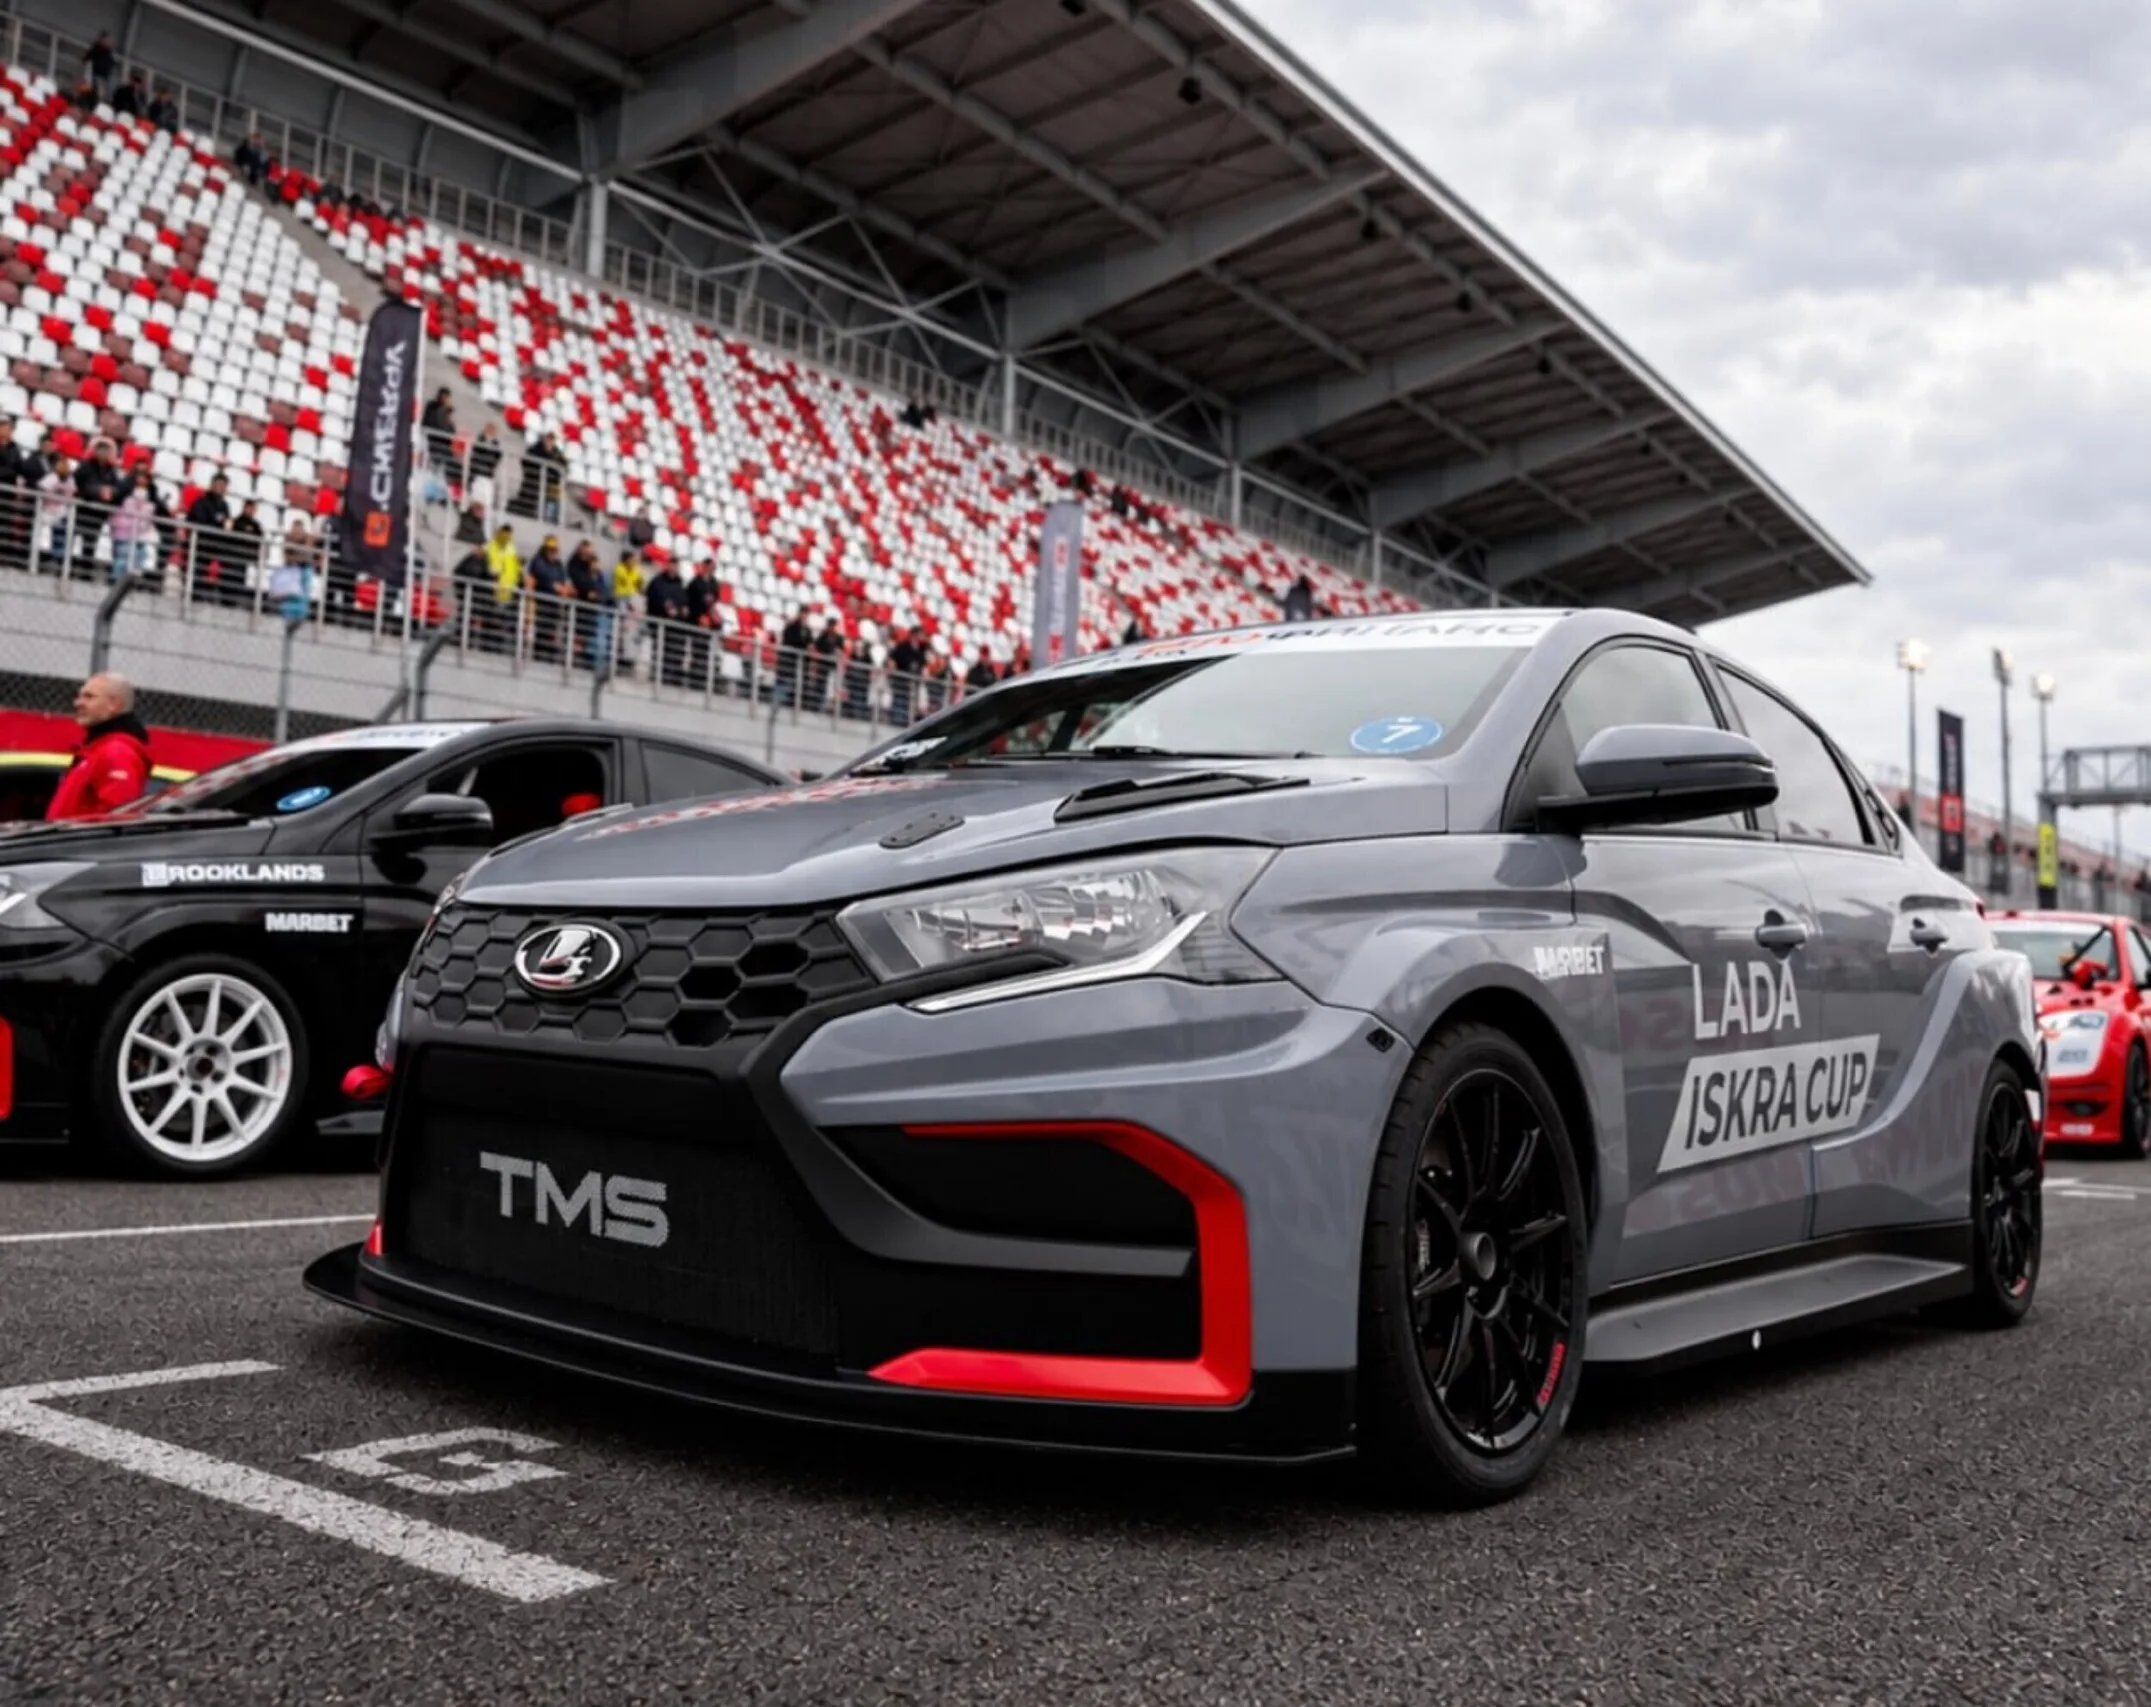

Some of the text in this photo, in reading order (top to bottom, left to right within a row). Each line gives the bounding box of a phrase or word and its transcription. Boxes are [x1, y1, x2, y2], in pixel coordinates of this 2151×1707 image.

[1692, 958, 1801, 1040] LADA
[1684, 1052, 1867, 1149] ISKRA CUP
[479, 1151, 669, 1248] TMS
